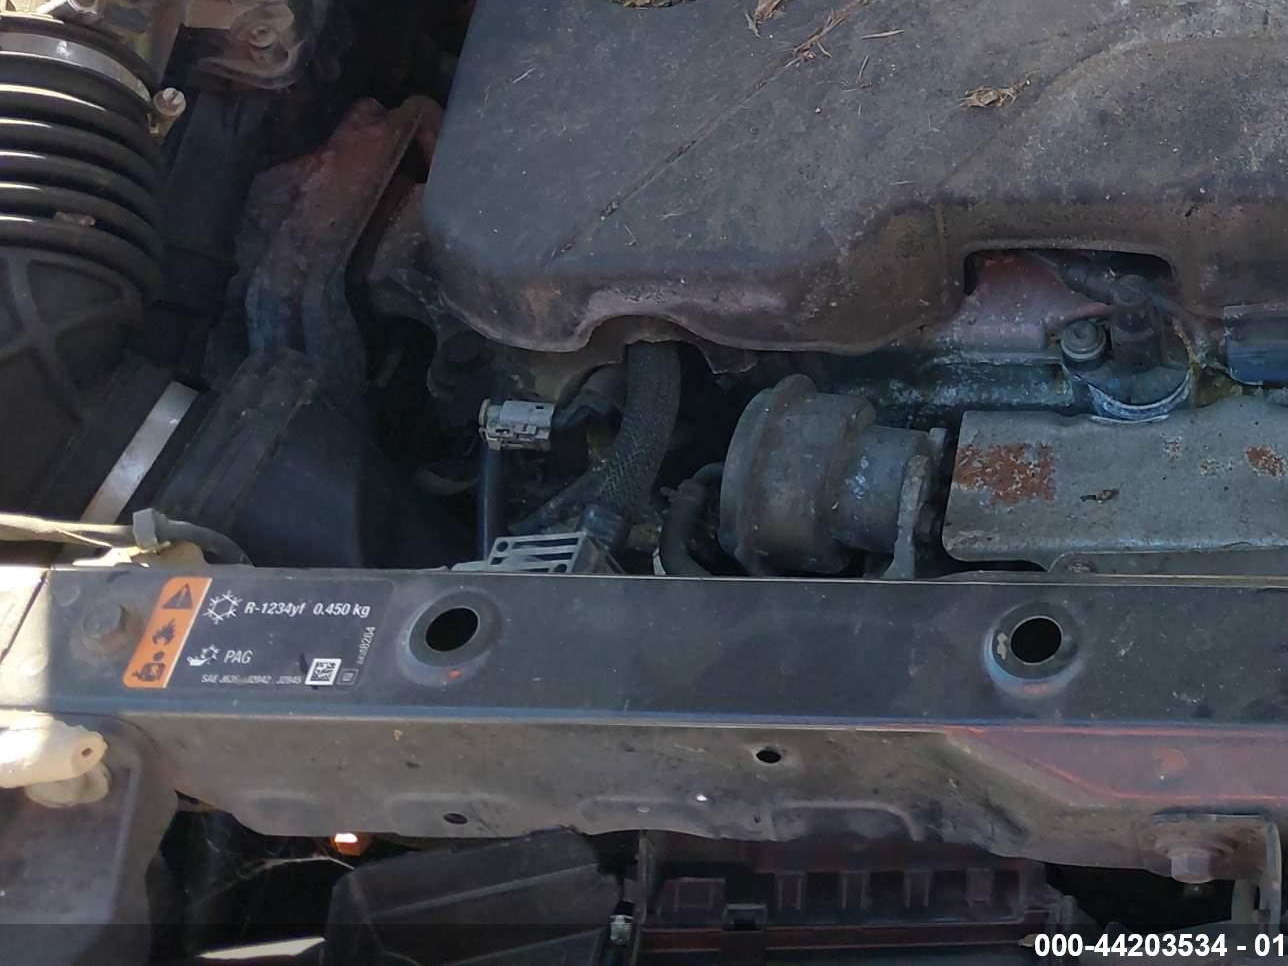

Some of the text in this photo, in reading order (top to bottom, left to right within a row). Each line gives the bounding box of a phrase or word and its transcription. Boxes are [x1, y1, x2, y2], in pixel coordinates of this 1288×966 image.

[243, 601, 371, 619] R-1234yf 0.450 kg
[223, 650, 253, 664] PAG
